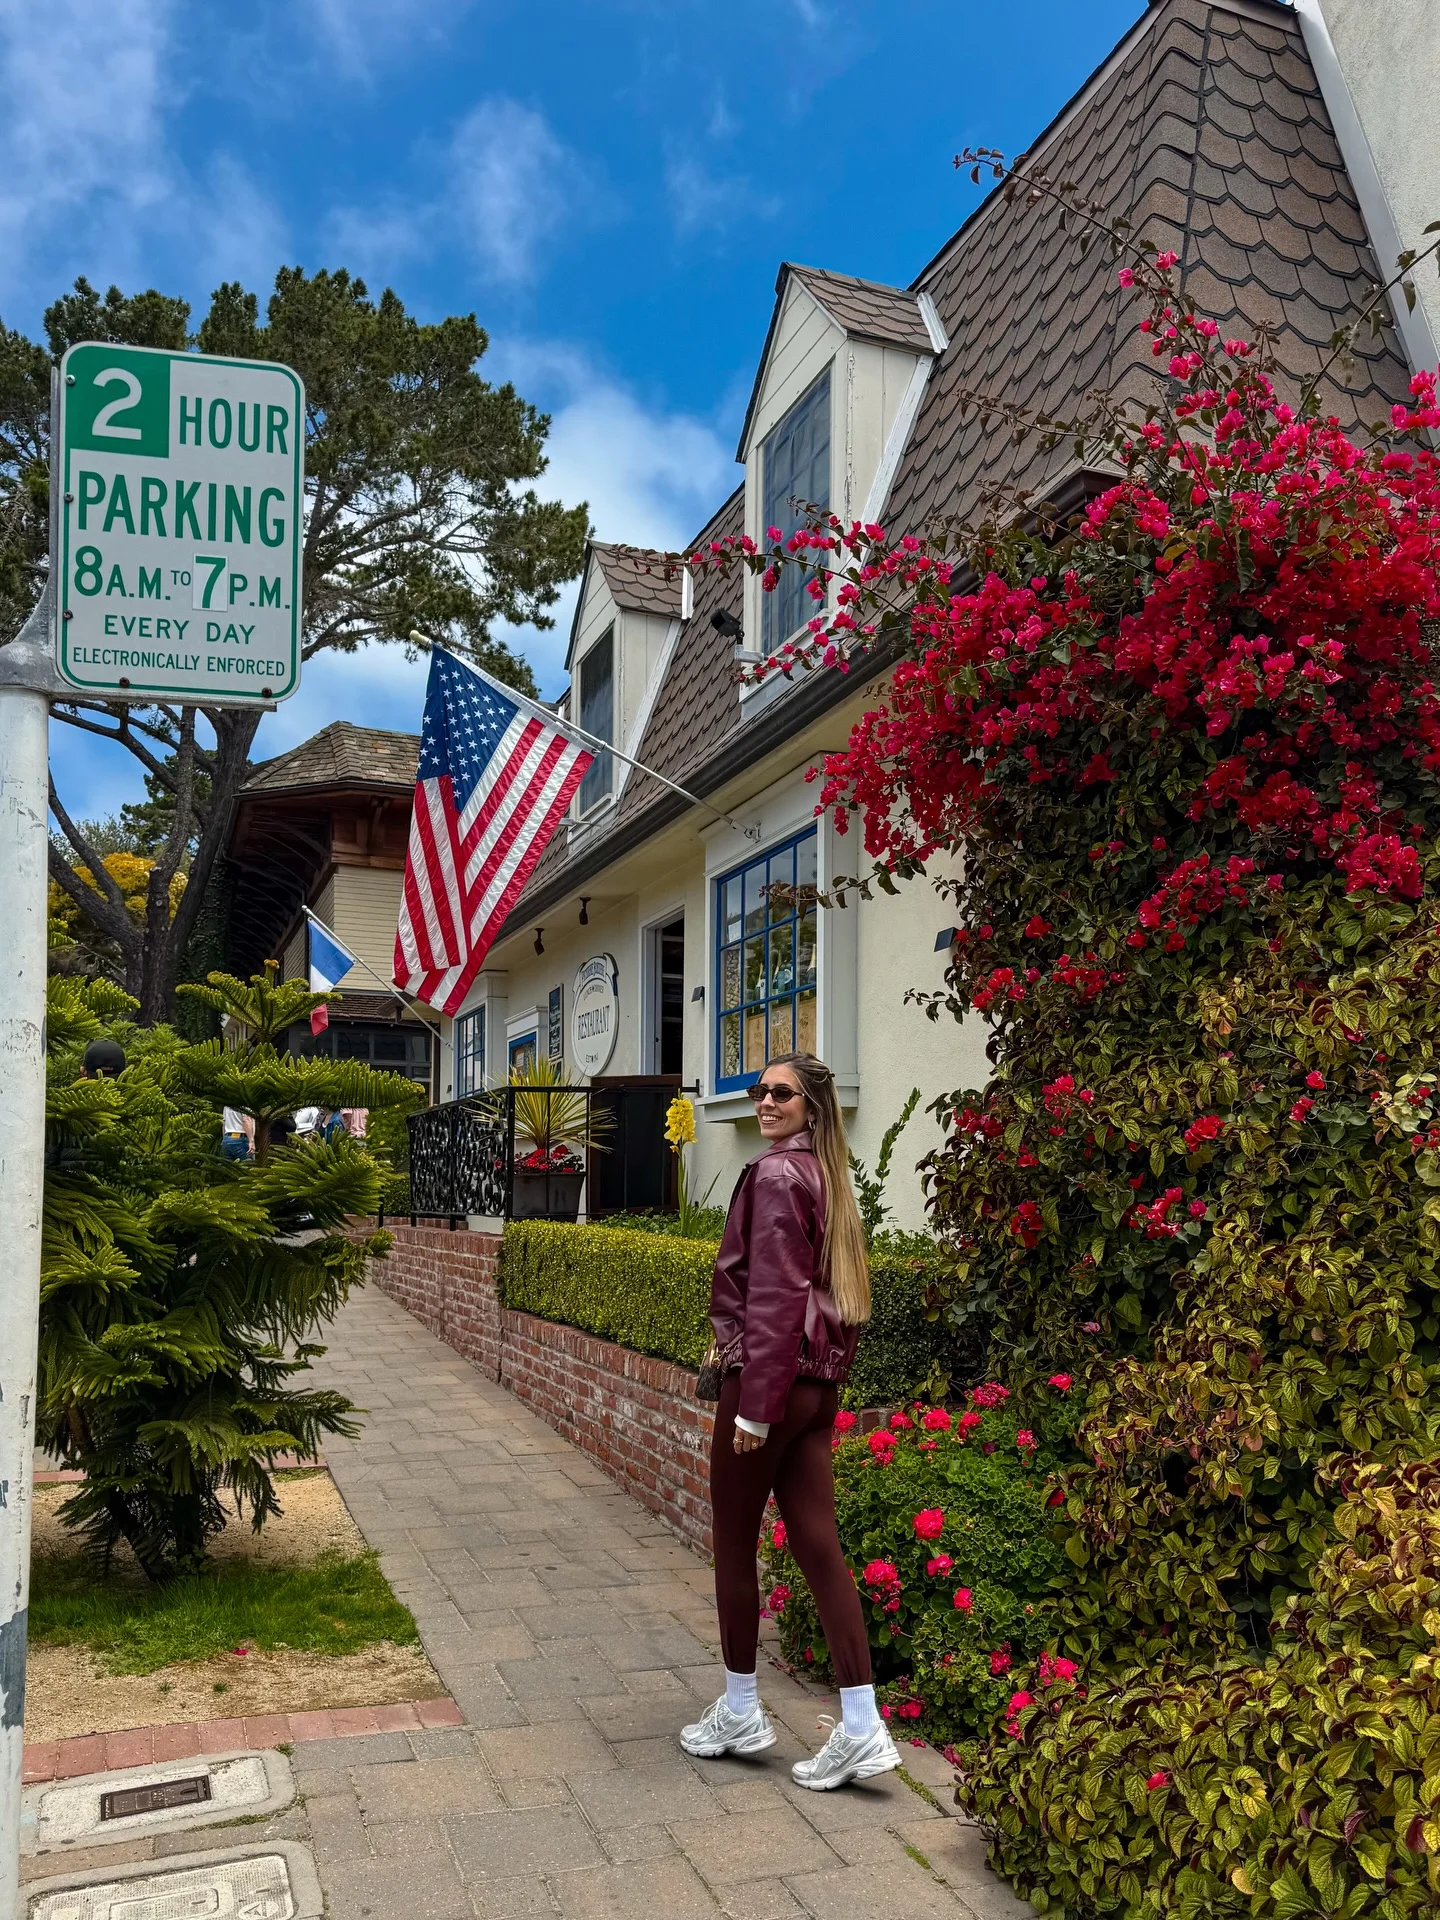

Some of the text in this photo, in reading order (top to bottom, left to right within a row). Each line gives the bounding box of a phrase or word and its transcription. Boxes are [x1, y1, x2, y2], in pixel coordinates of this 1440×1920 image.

[91, 367, 290, 455] 2 HOUR
[77, 470, 286, 548] PARKING
[171, 570, 191, 587] TO
[104, 615, 256, 645] EVERY DAY
[73, 647, 285, 677] ELECTRONICALLY ENFORCED
[577, 1005, 610, 1041] RESTAURANT
